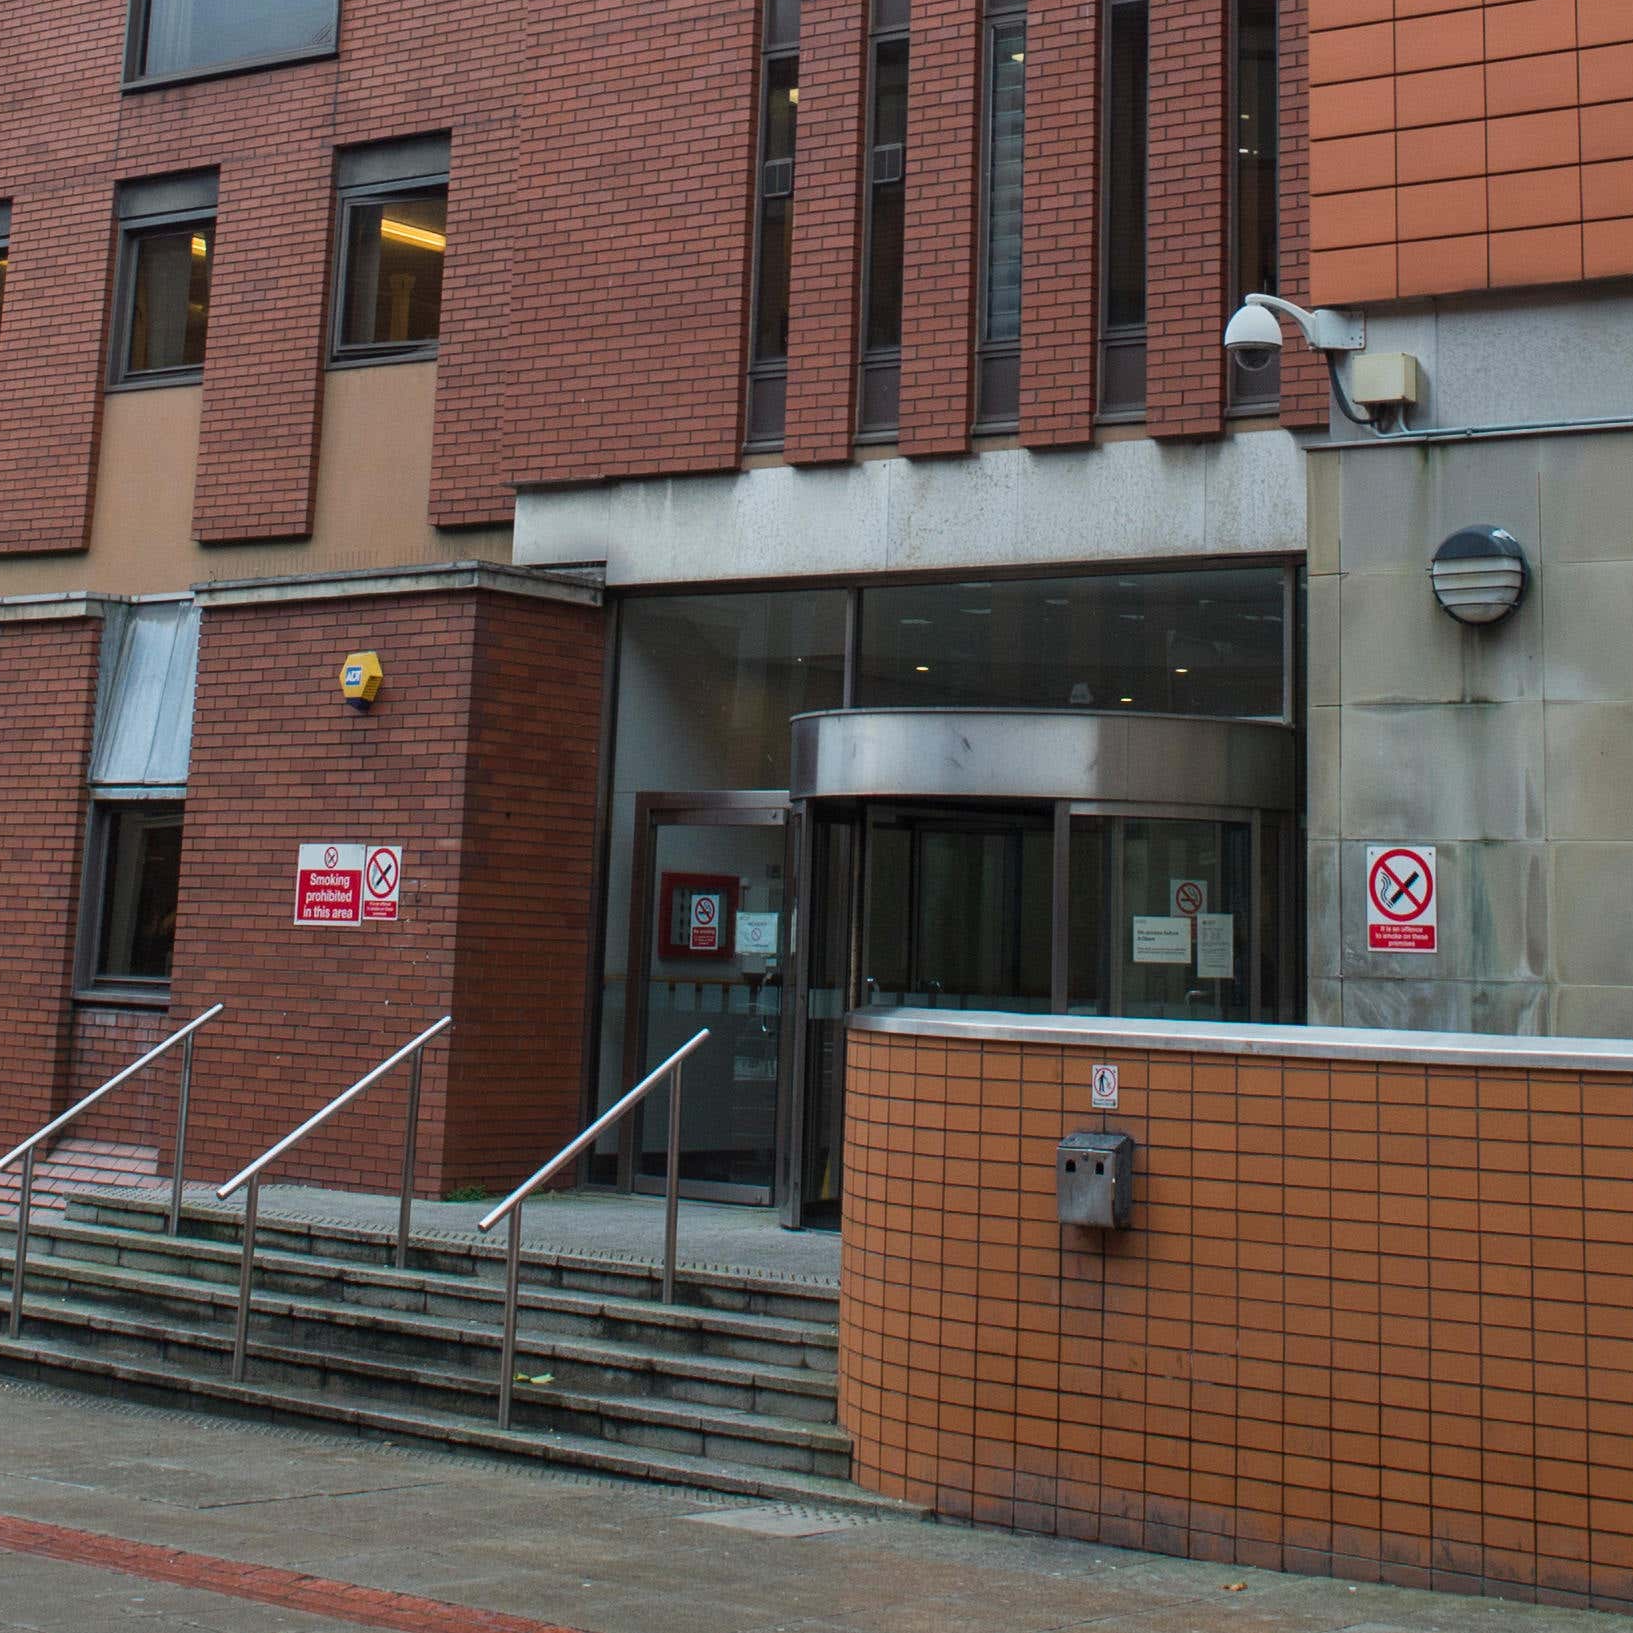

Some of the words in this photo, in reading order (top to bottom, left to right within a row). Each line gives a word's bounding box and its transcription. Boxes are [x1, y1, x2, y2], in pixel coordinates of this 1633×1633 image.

[309, 873, 350, 888] Smoking
[306, 890, 352, 904] prohibited
[303, 905, 312, 918] in
[313, 906, 330, 919] this
[332, 908, 353, 919] area
